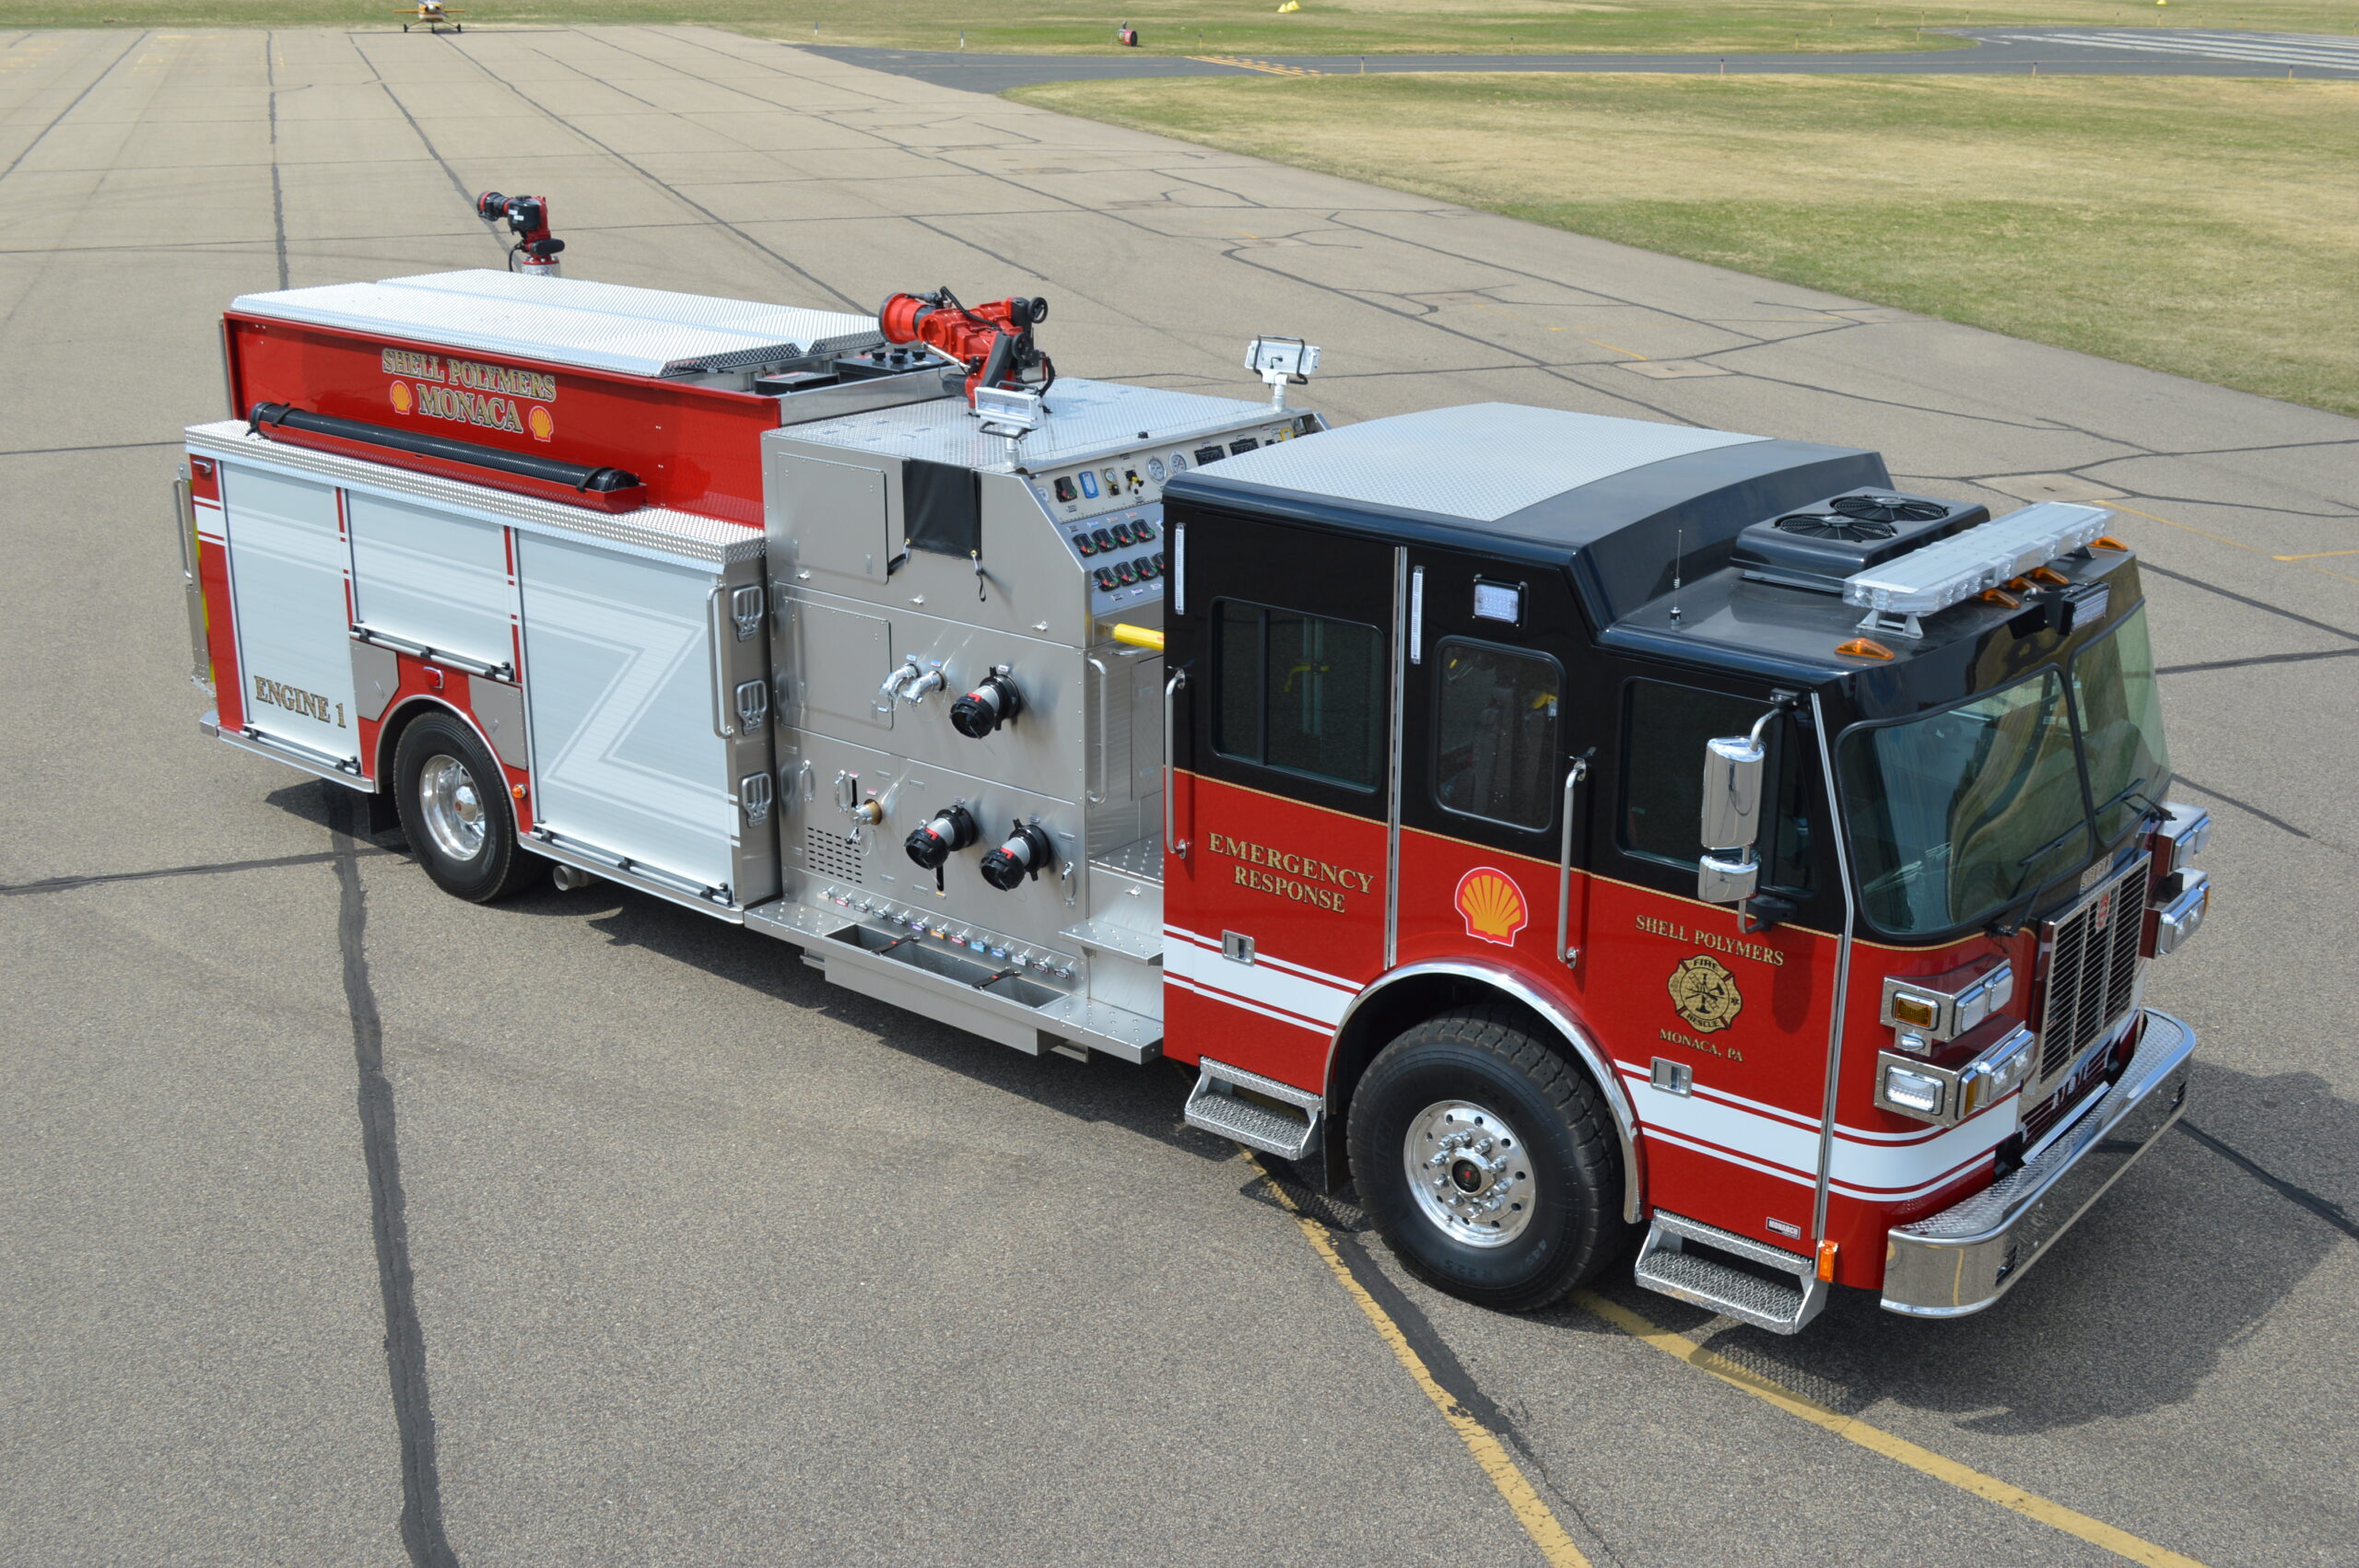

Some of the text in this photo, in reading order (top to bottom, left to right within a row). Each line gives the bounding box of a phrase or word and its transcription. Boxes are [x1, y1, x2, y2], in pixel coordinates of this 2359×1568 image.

[381, 347, 557, 402] SHELL POLYMERS
[417, 384, 523, 433] MONACA
[253, 675, 346, 728] ENGINE 1
[1209, 832, 1374, 894] EMERGENCY
[1234, 865, 1345, 914] RESPONSE
[1636, 915, 1784, 965] SHELL POLYMERS
[1693, 959, 1719, 970] FIRE
[1686, 1012, 1719, 1027] RESCUE
[1660, 1028, 1743, 1062] MONACA, PA
